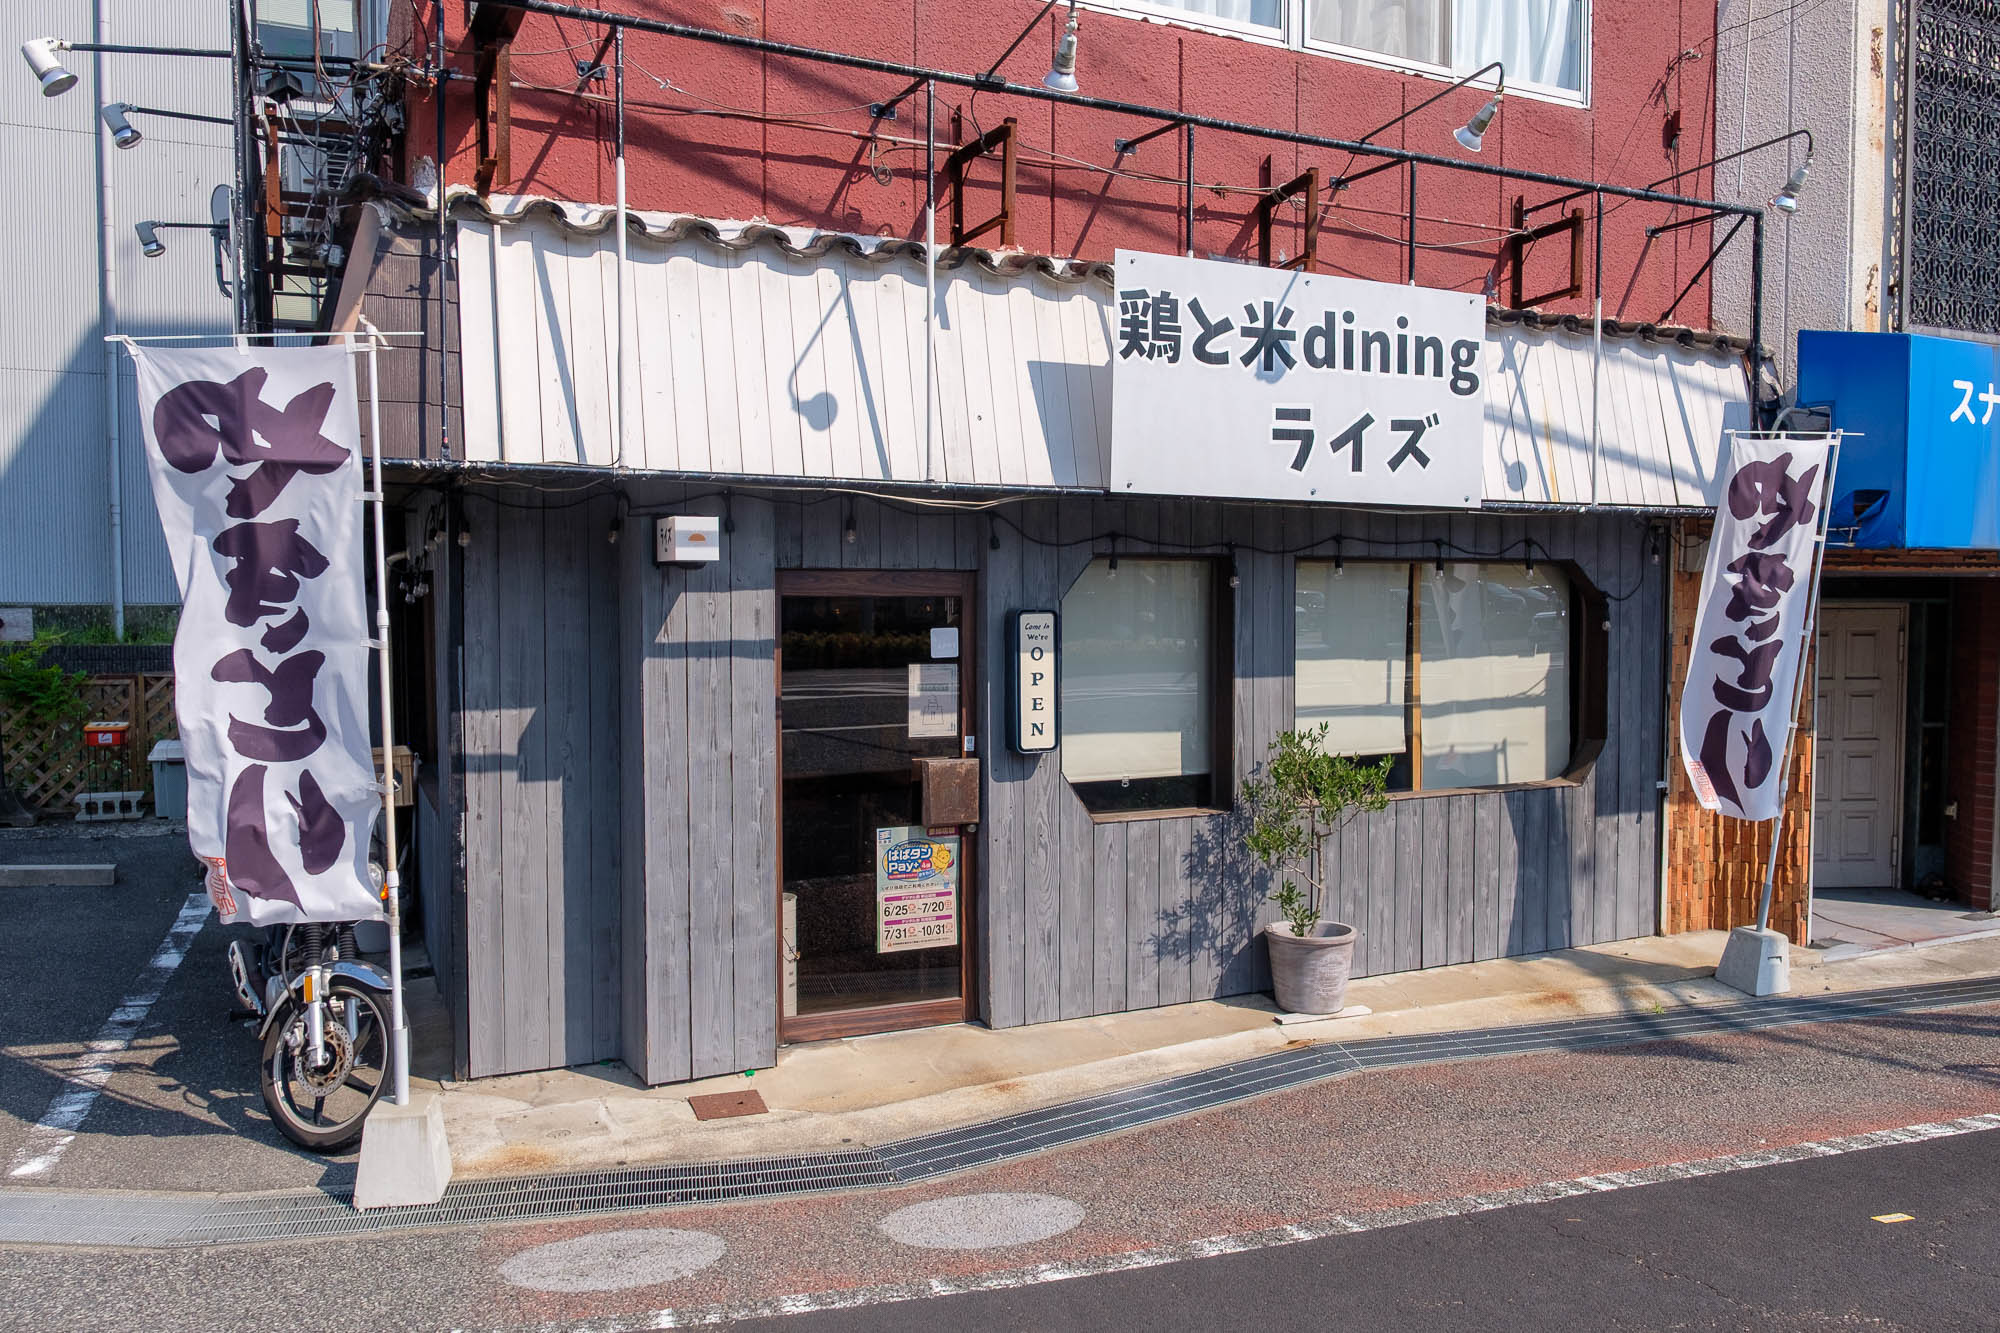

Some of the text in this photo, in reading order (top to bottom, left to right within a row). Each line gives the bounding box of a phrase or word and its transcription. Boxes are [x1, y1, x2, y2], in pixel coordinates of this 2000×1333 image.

[1119, 288, 1480, 396] 鶏と米dining
[1272, 408, 1440, 473] ライズ
[1024, 621, 1050, 630] Come In
[1027, 633, 1048, 641] We're
[1030, 646, 1044, 736] OPEN
[884, 905, 908, 917] 6/25
[922, 901, 945, 913] 7/20
[884, 928, 907, 940] 7/31
[922, 924, 945, 936] 10/31
